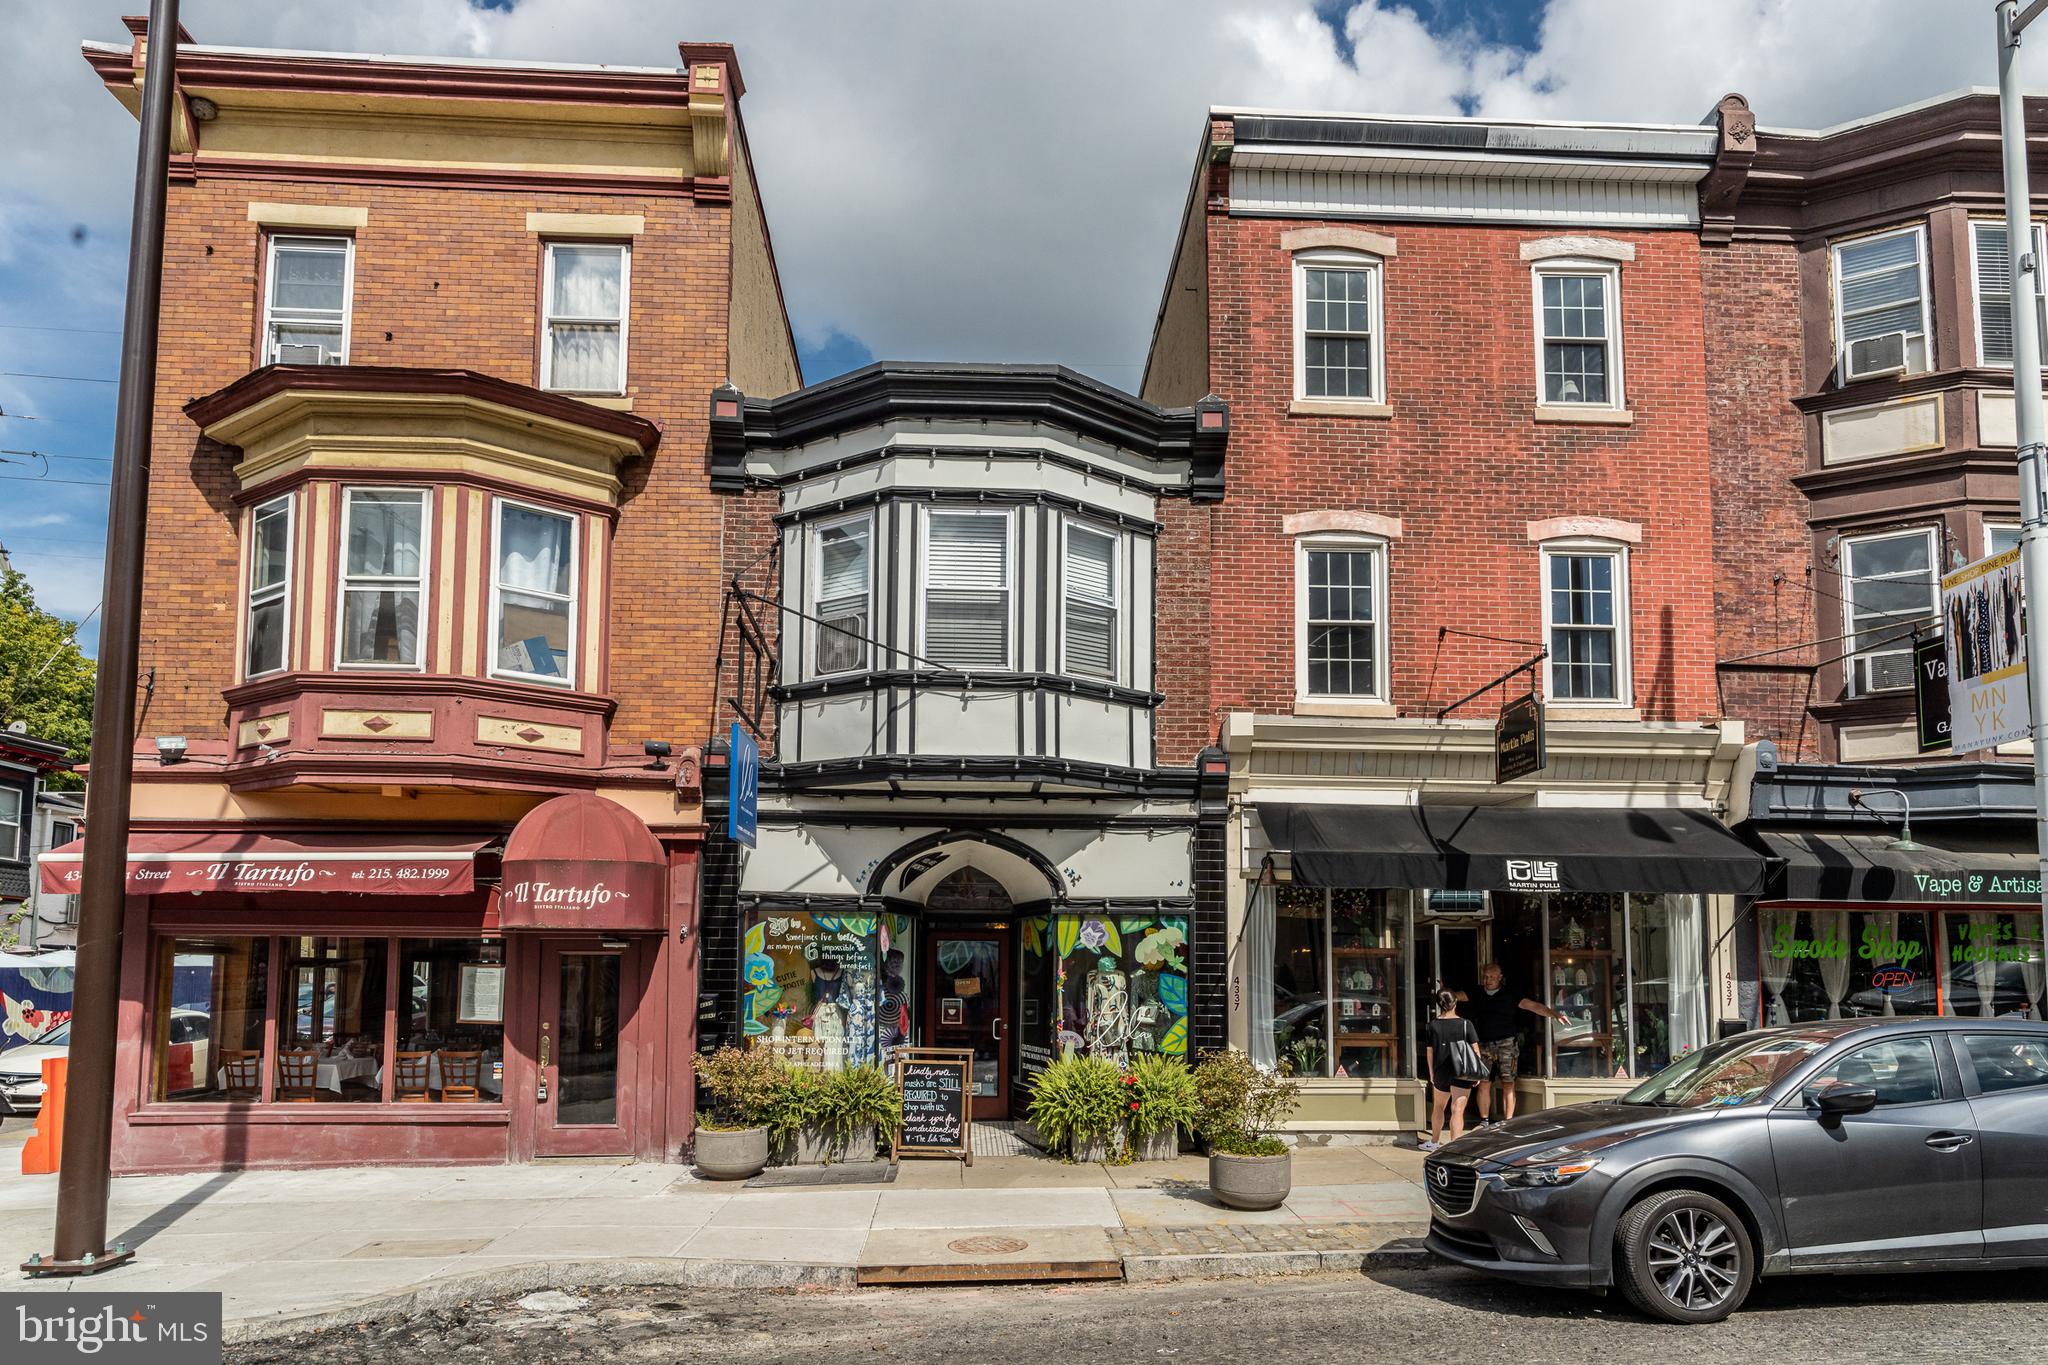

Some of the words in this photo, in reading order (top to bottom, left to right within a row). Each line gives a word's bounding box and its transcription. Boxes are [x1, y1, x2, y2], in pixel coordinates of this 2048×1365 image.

[1945, 575, 1959, 588] LIVE
[1961, 567, 1980, 580] SHOP
[1981, 560, 1999, 572] DINE
[2001, 551, 2020, 565] PLAY
[1500, 737, 1519, 754] Martin
[1520, 729, 1535, 746] Pulli
[1954, 729, 2029, 752] MANAYUNK.COM
[136, 869, 171, 880] Street
[206, 862, 230, 880] Il
[233, 861, 315, 887] Tartufo
[351, 870, 365, 879] tel:
[396, 868, 449, 879] 482.1999
[1914, 875, 1962, 896] Vape
[1968, 875, 1983, 893] &
[1988, 875, 2042, 893] Artisa
[514, 881, 529, 903] Il
[532, 882, 611, 909] Tartufo
[785, 933, 818, 945] Sometimes
[1773, 923, 1848, 960] Smoke
[1858, 923, 1923, 969] Shop
[775, 944, 793, 955] many
[804, 942, 819, 961] 6
[822, 943, 855, 955] impossible
[822, 953, 844, 964] things
[846, 953, 868, 963] before
[775, 970, 797, 983] CUTIE
[1872, 972, 1915, 987] OPEN
[1087, 990, 1152, 1048] lila
[757, 1036, 783, 1044] SHOP
[783, 1035, 865, 1044] INTERNATIONALLY
[773, 1046, 785, 1055] NO
[787, 1046, 803, 1055] JET
[805, 1046, 849, 1056] REQUIRED
[904, 1065, 932, 1080] kindly
[904, 1079, 925, 1088] masks
[938, 1077, 960, 1089] STILL
[904, 1089, 937, 1100] REQUIRED
[940, 1093, 949, 1101] to
[903, 1102, 919, 1113] shop
[920, 1102, 934, 1111] with
[903, 1112, 927, 1122] thank
[928, 1115, 944, 1126] you
[945, 1113, 957, 1126] for
